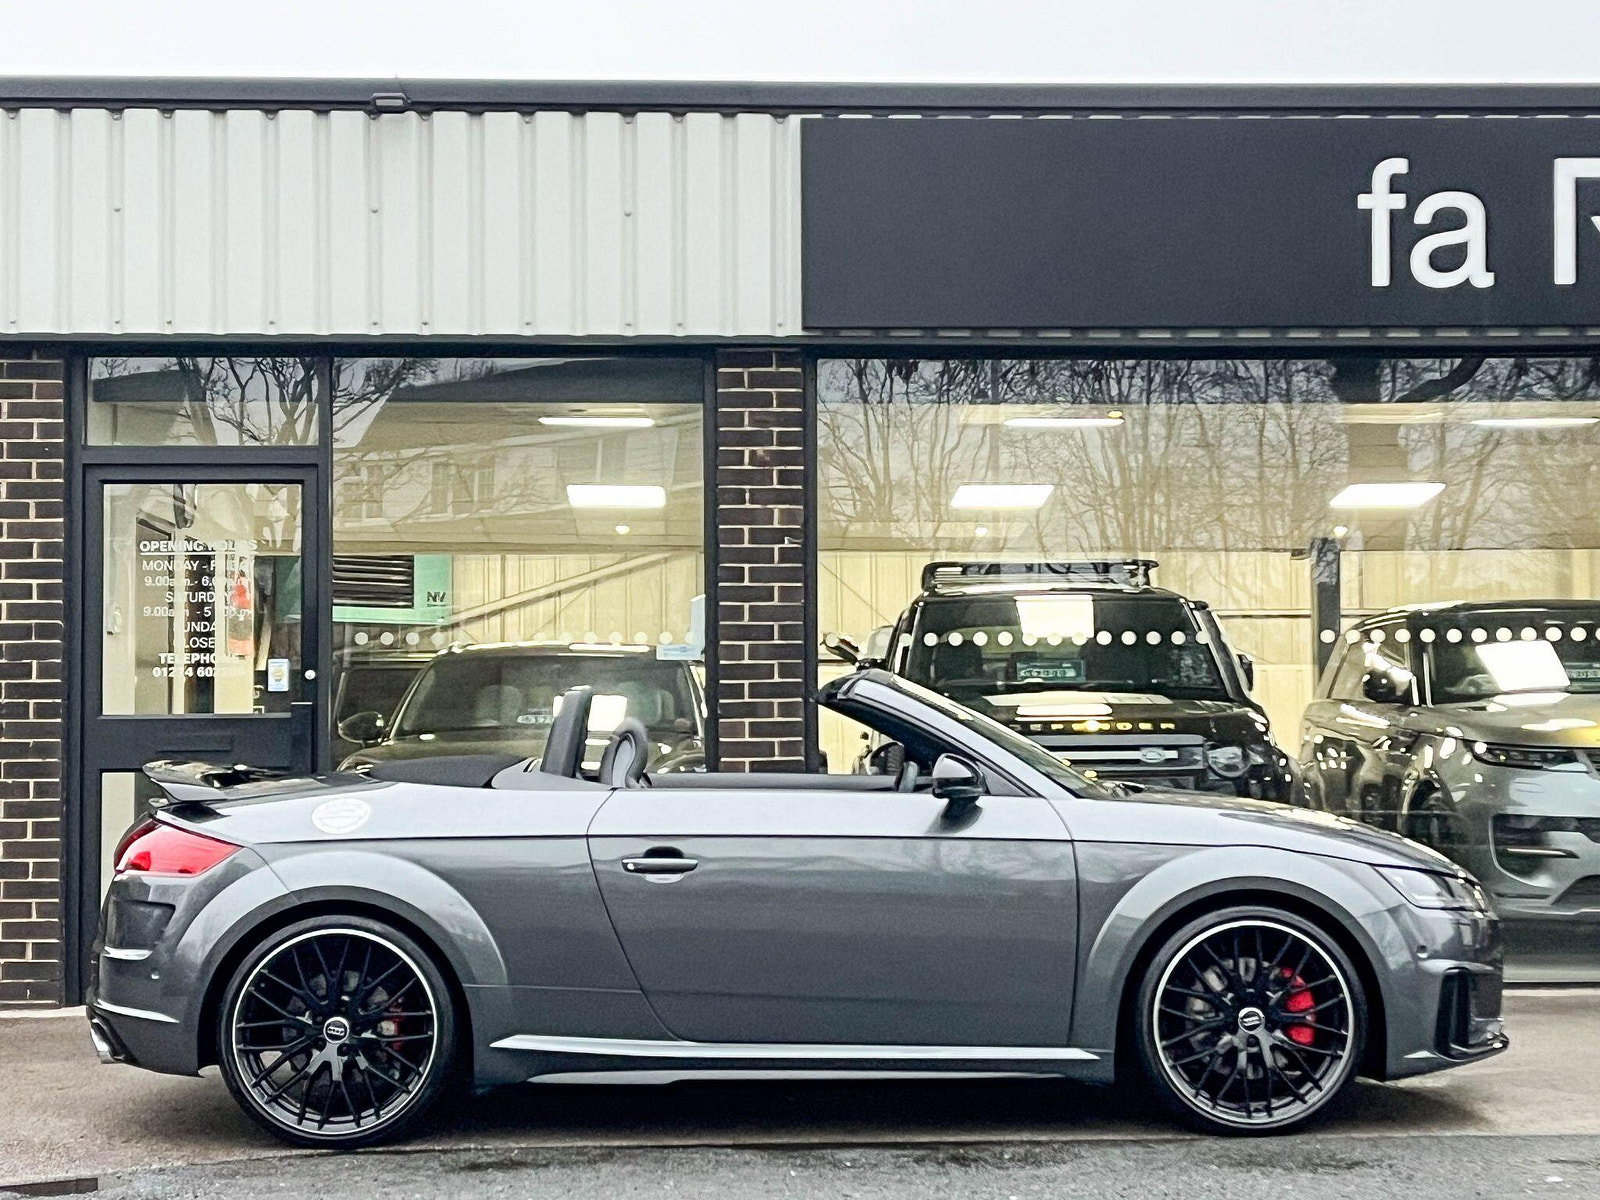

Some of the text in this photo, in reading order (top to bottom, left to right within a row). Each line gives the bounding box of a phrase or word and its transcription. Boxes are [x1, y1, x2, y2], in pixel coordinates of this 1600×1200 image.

[1357, 157, 1495, 289] fa
[139, 540, 204, 552] OPENING
[142, 560, 200, 571] MONAY
[174, 622, 217, 633] UNDA
[158, 653, 221, 664] TEEPHO
[152, 666, 193, 677] 0124
